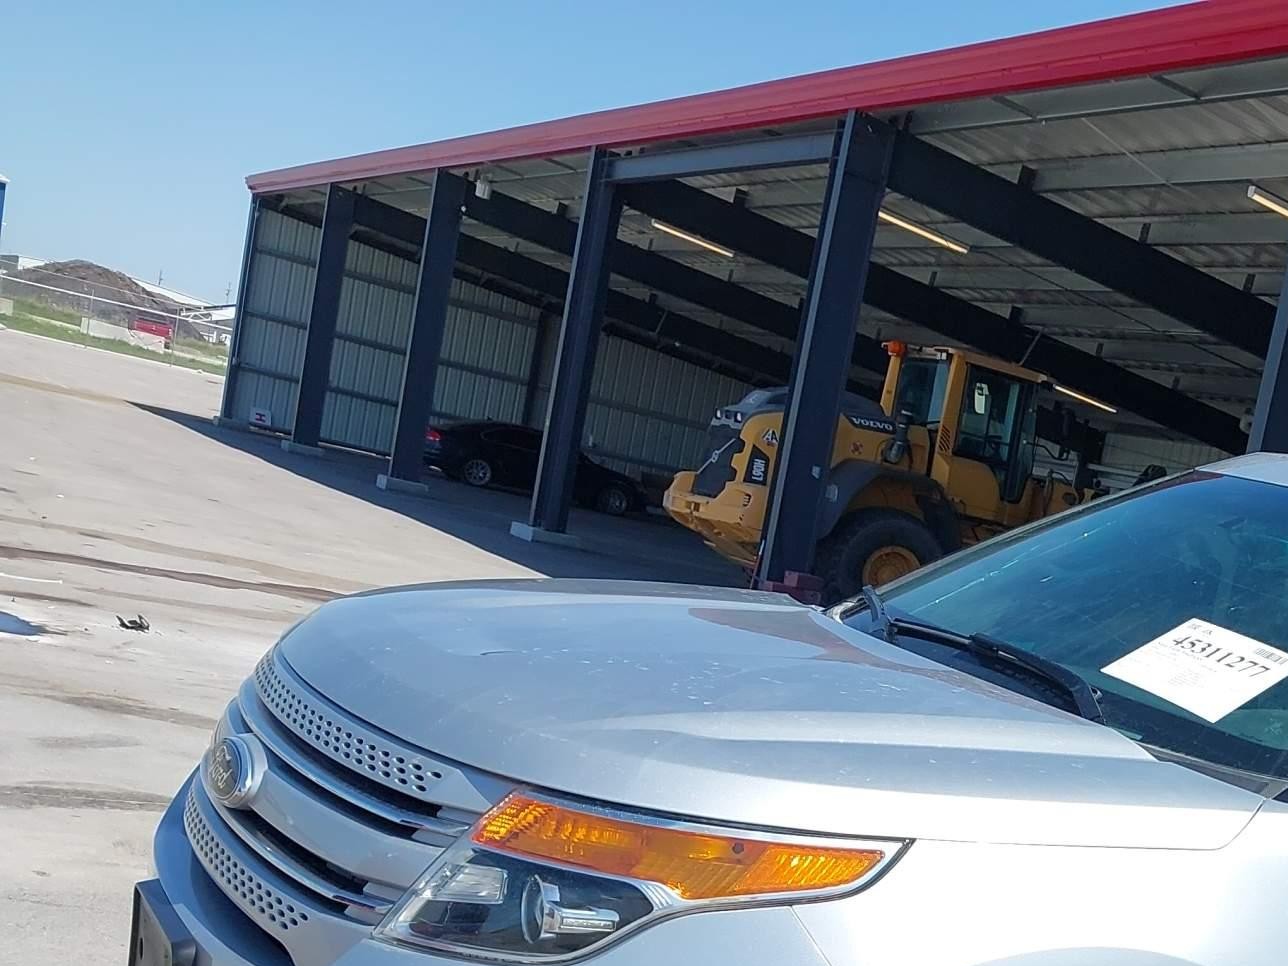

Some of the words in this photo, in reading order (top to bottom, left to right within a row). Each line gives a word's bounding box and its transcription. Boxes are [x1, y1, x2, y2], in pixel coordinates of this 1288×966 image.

[850, 416, 893, 431] VOLVO
[752, 458, 767, 481] L90H
[1172, 635, 1271, 678] 45311277
